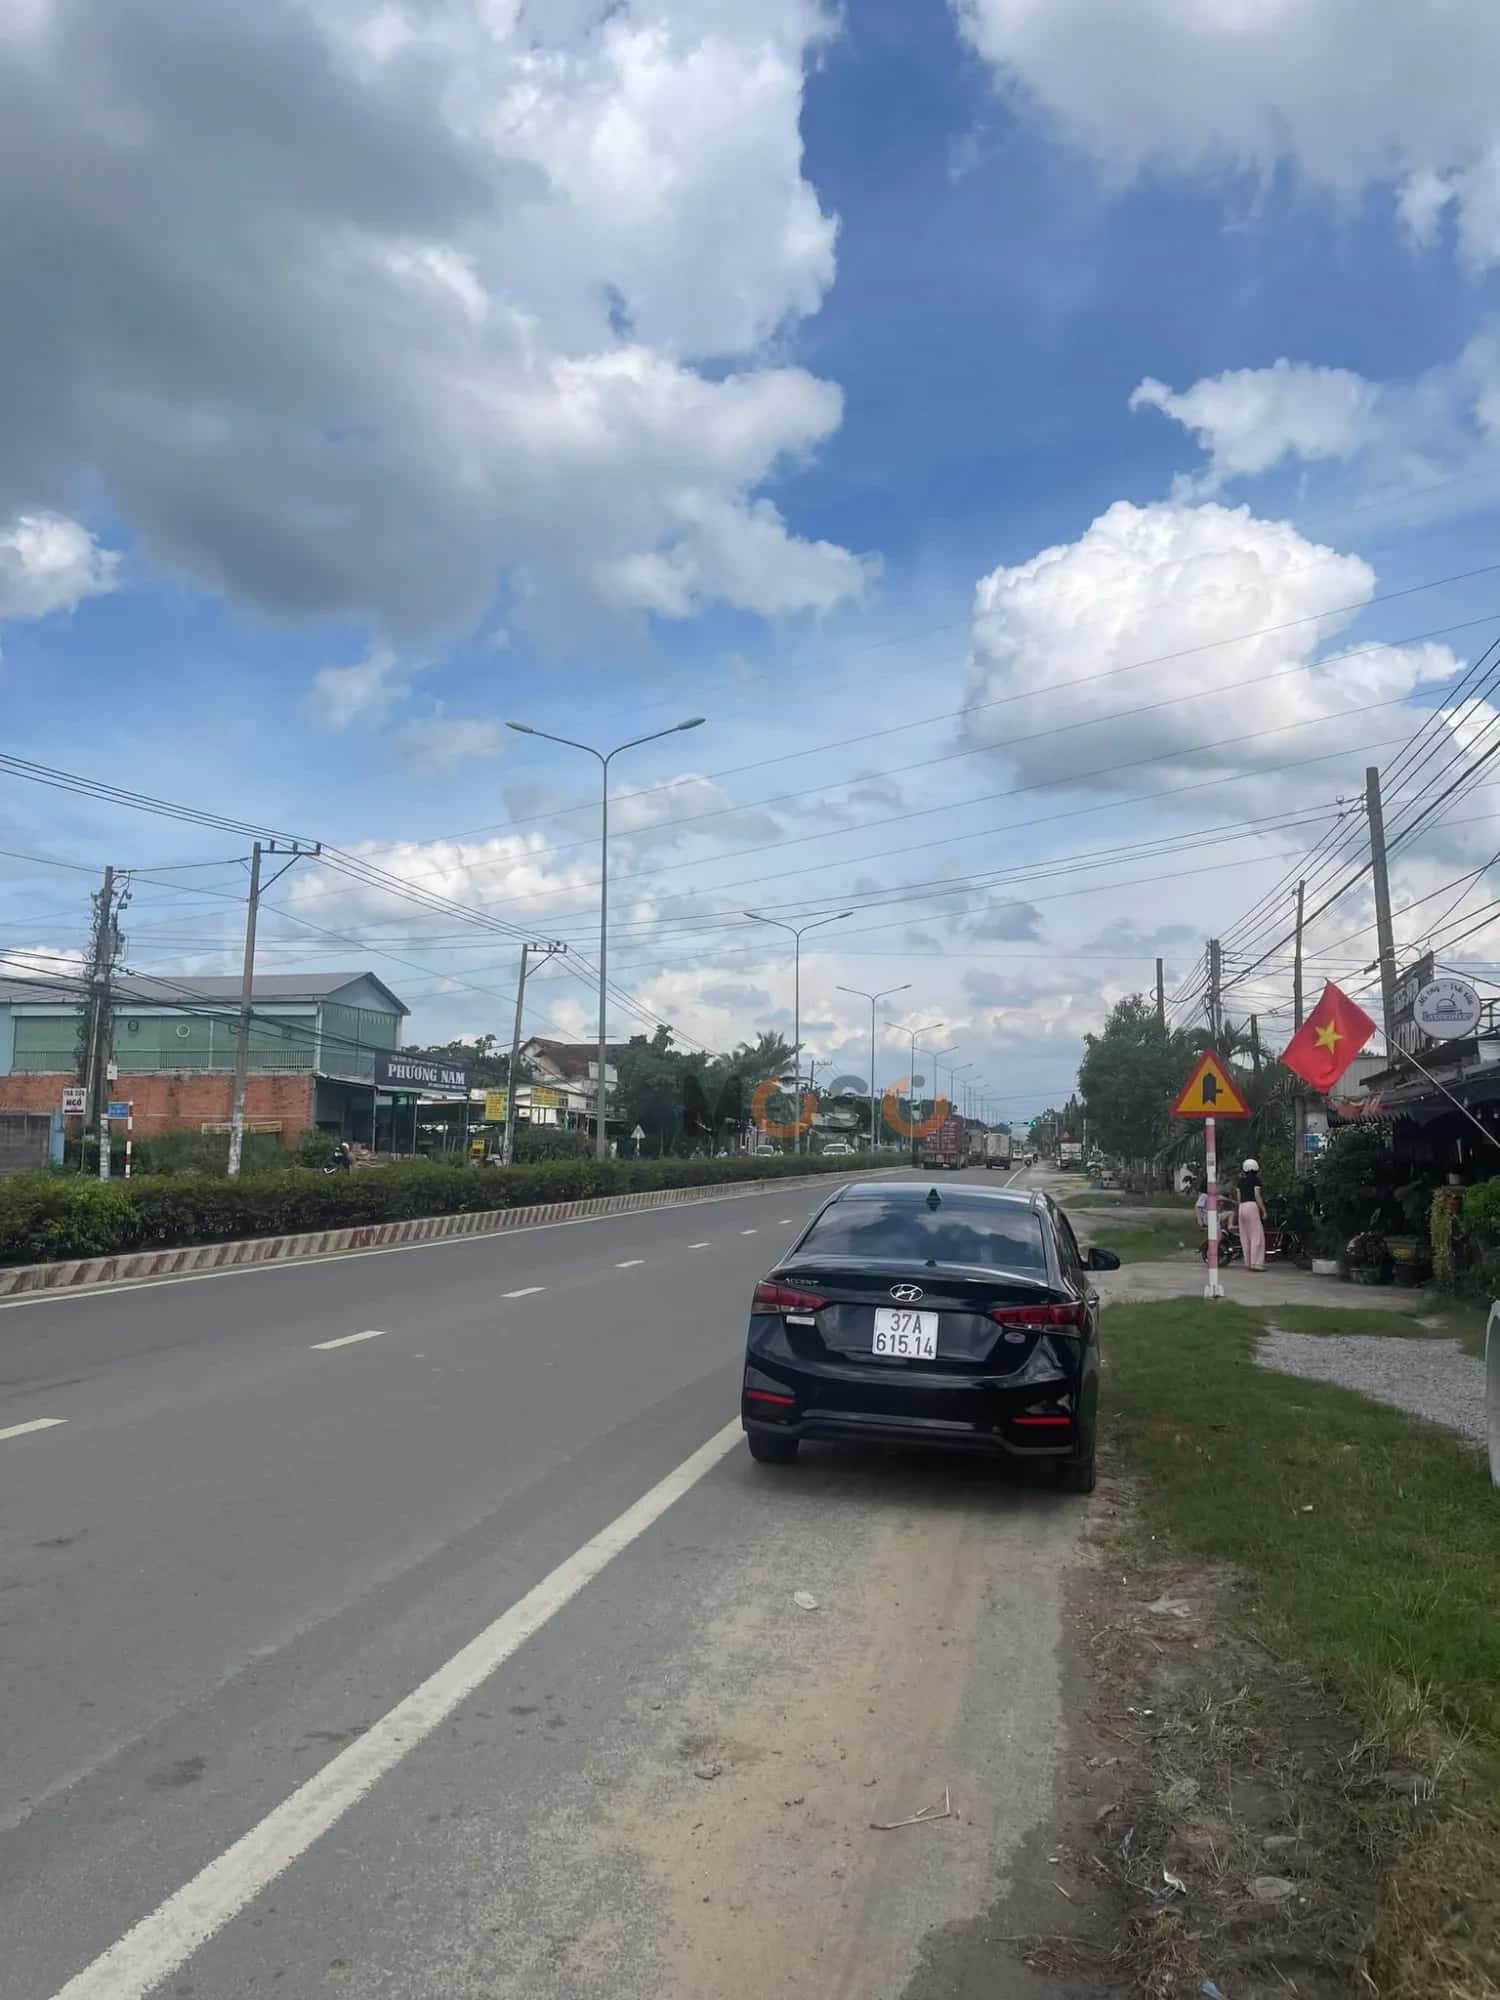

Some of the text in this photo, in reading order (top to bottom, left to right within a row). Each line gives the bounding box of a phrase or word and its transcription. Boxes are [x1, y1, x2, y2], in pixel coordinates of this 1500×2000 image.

[387, 1063, 465, 1085] PHƯƠNG NAM
[890, 1313, 922, 1335] 37A
[876, 1332, 934, 1357] 615.14
